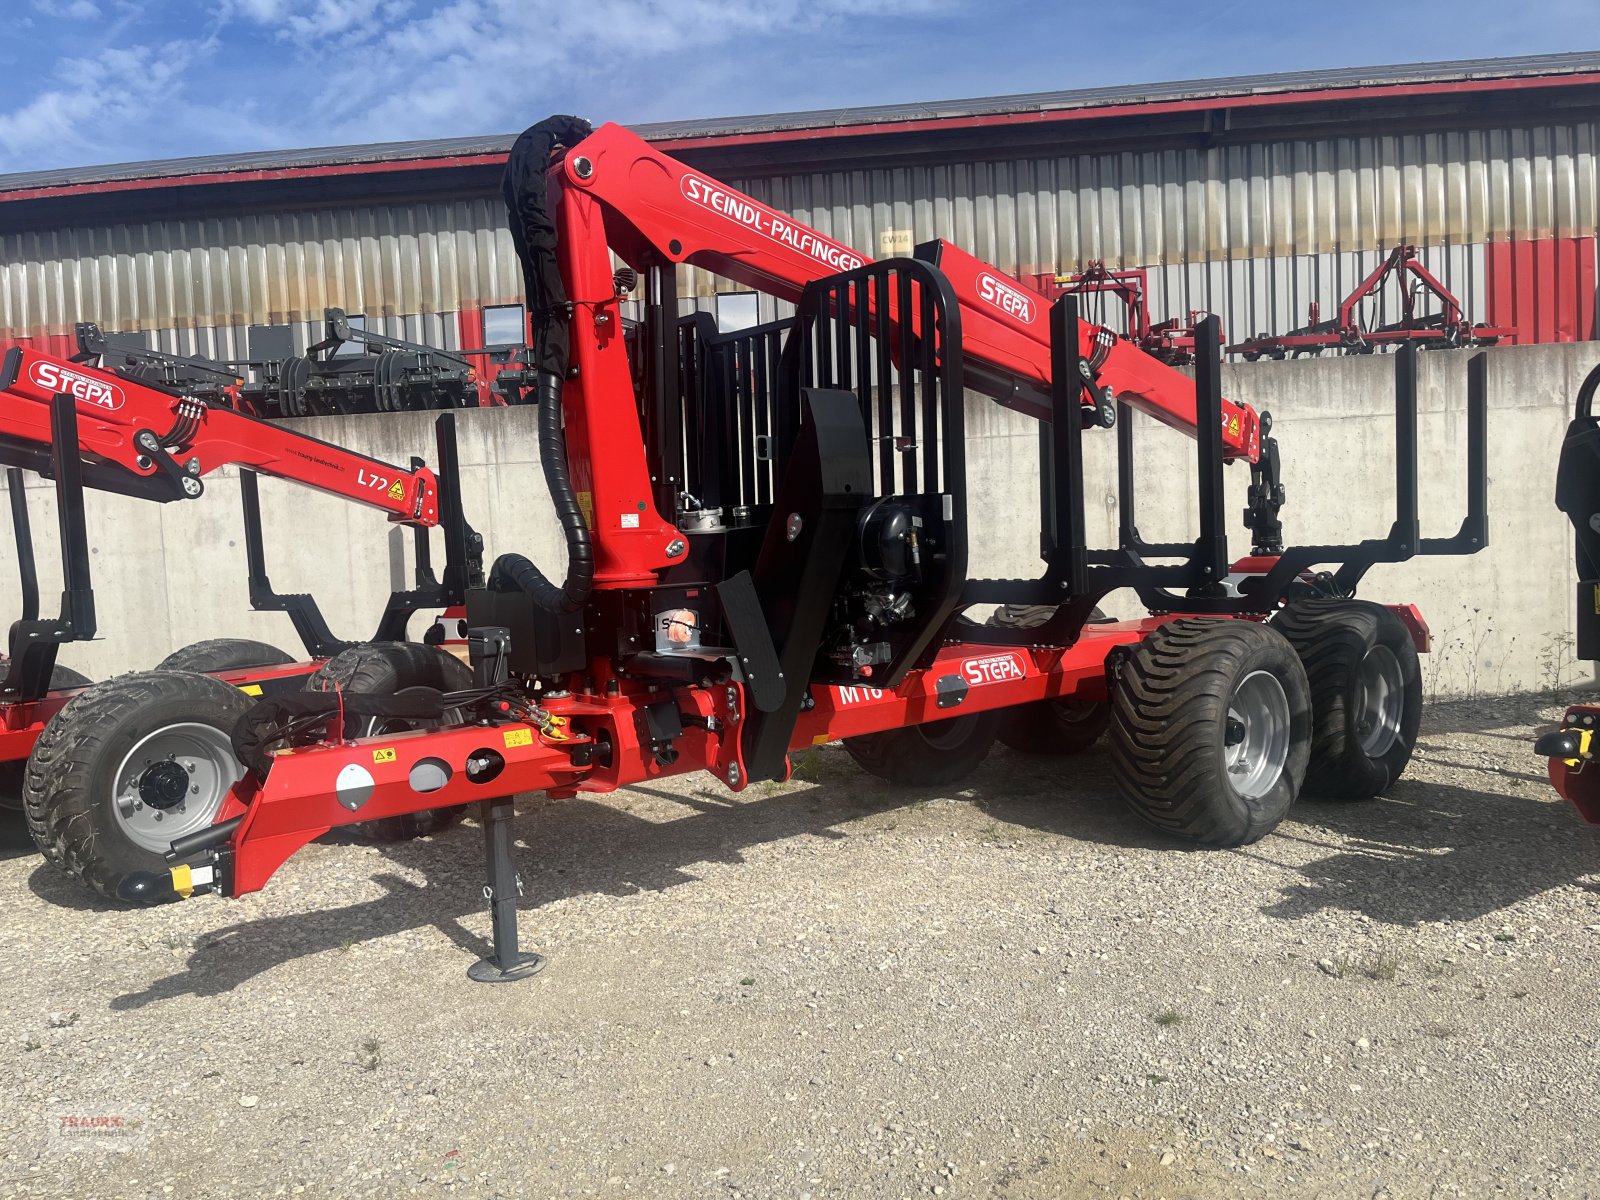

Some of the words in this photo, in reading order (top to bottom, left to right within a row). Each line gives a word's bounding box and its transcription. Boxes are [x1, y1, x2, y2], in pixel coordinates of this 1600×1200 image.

[882, 234, 909, 244] CW14
[980, 275, 1029, 322] STEPA
[36, 363, 114, 408] STEPA
[965, 660, 1023, 684] STEPA
